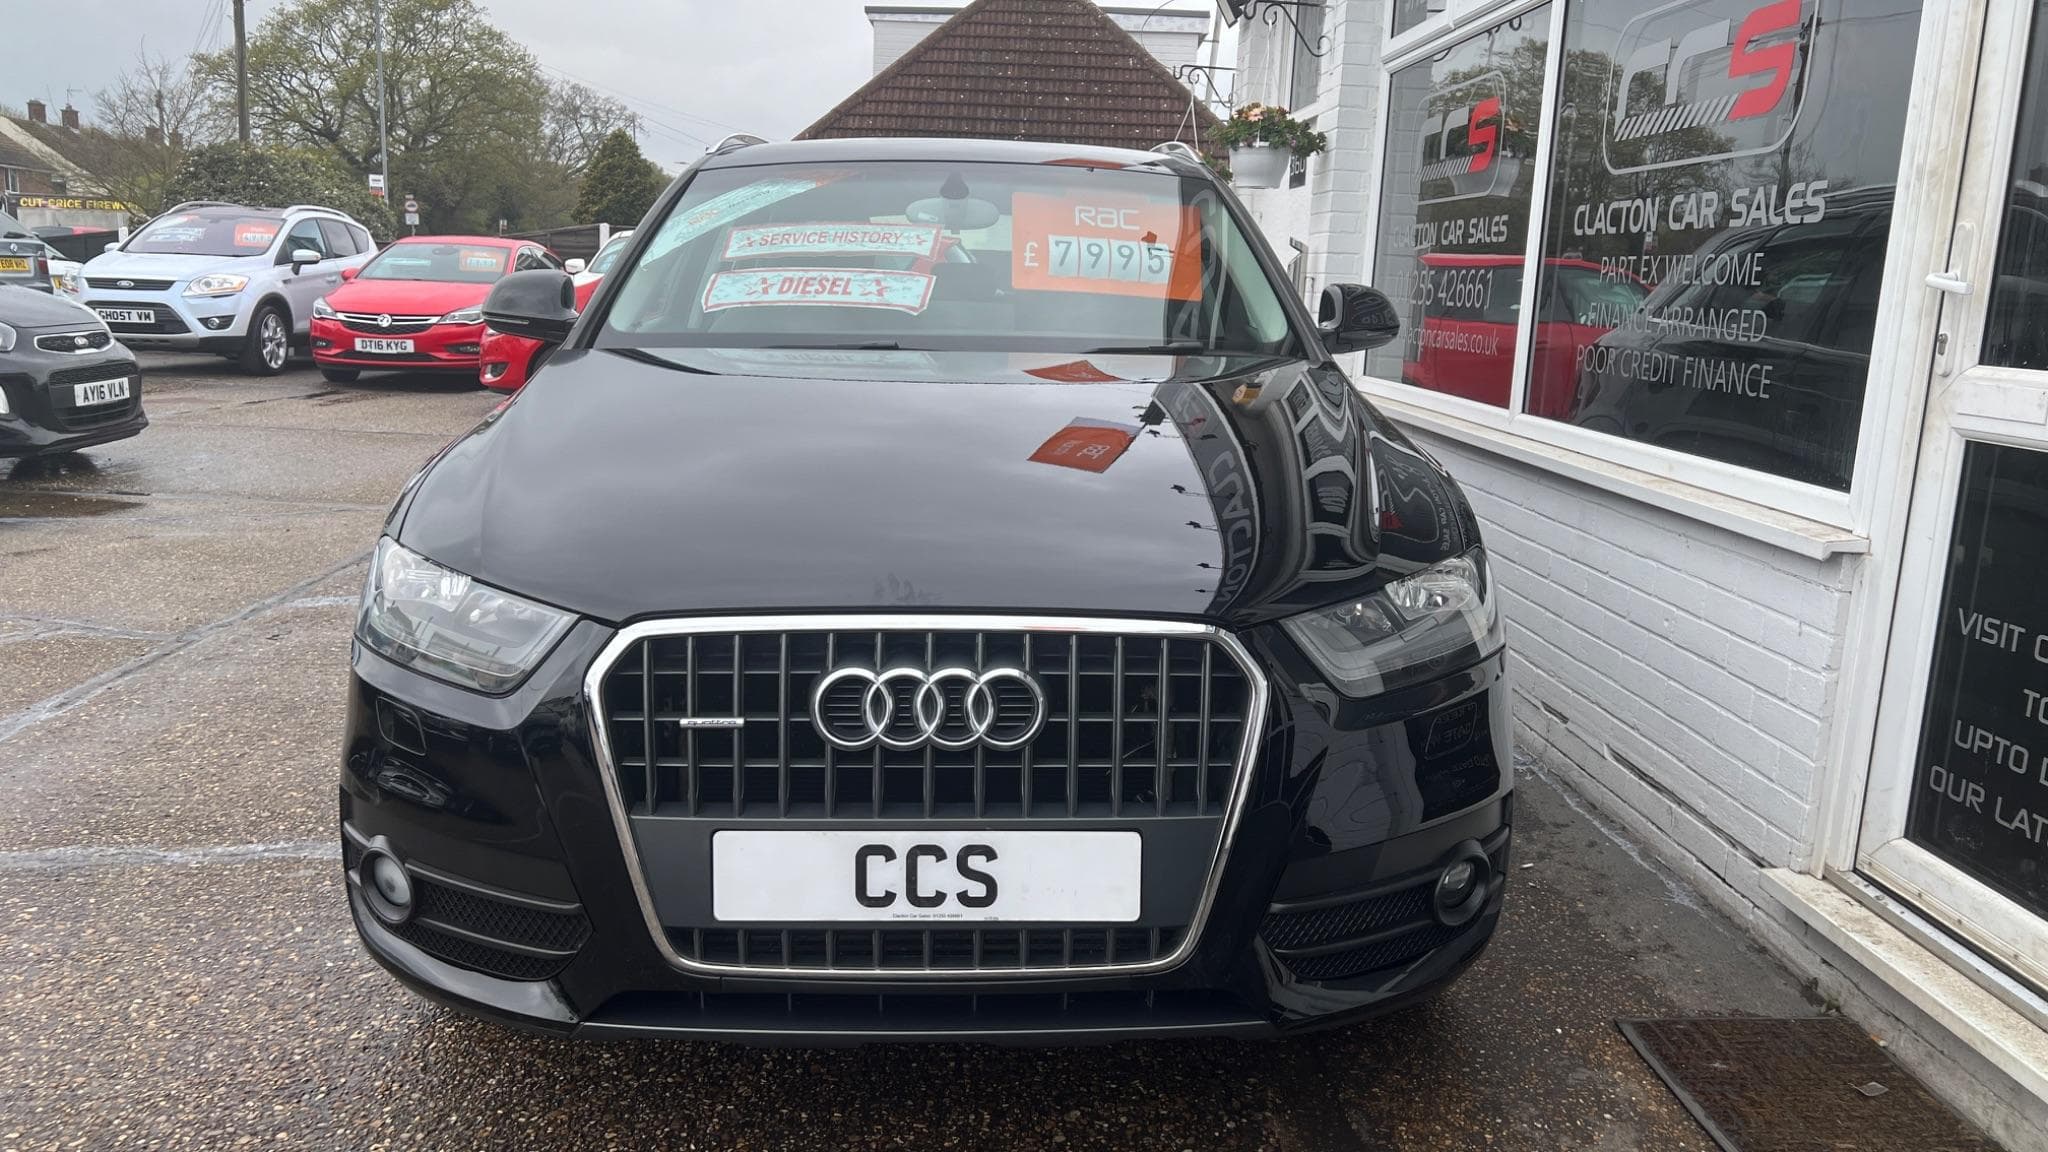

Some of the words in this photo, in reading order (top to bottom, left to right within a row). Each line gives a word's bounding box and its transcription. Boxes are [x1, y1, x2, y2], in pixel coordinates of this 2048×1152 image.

[1574, 197, 1660, 236] CLACTON
[1668, 191, 1719, 231] CAR
[1729, 180, 1829, 228] SALES
[758, 232, 828, 247] SERVICE
[832, 231, 903, 245] HISTORY
[1393, 221, 1438, 247] CLACTON
[1441, 218, 1465, 245] CAR
[1468, 214, 1510, 244] SALES
[777, 277, 853, 296] DIESEL
[1600, 255, 1637, 284] PART
[1640, 255, 1661, 284] EX
[1665, 252, 1765, 286] WELCOME
[1438, 269, 1494, 311] 426661
[1587, 302, 1655, 334] FINANCE
[1657, 306, 1768, 342] ARRANGED
[361, 339, 383, 349] DT16
[386, 339, 408, 350] KYG
[83, 384, 106, 404] AY16
[107, 381, 126, 398] VLN
[1576, 344, 1616, 377] POOR
[1620, 349, 1680, 385] CREDIT
[1683, 356, 1774, 400] FINANCE
[1958, 607, 2026, 653] VISIT
[1954, 719, 2030, 775] UPTO
[1929, 765, 1985, 815] OUR
[854, 843, 999, 908] CCS
